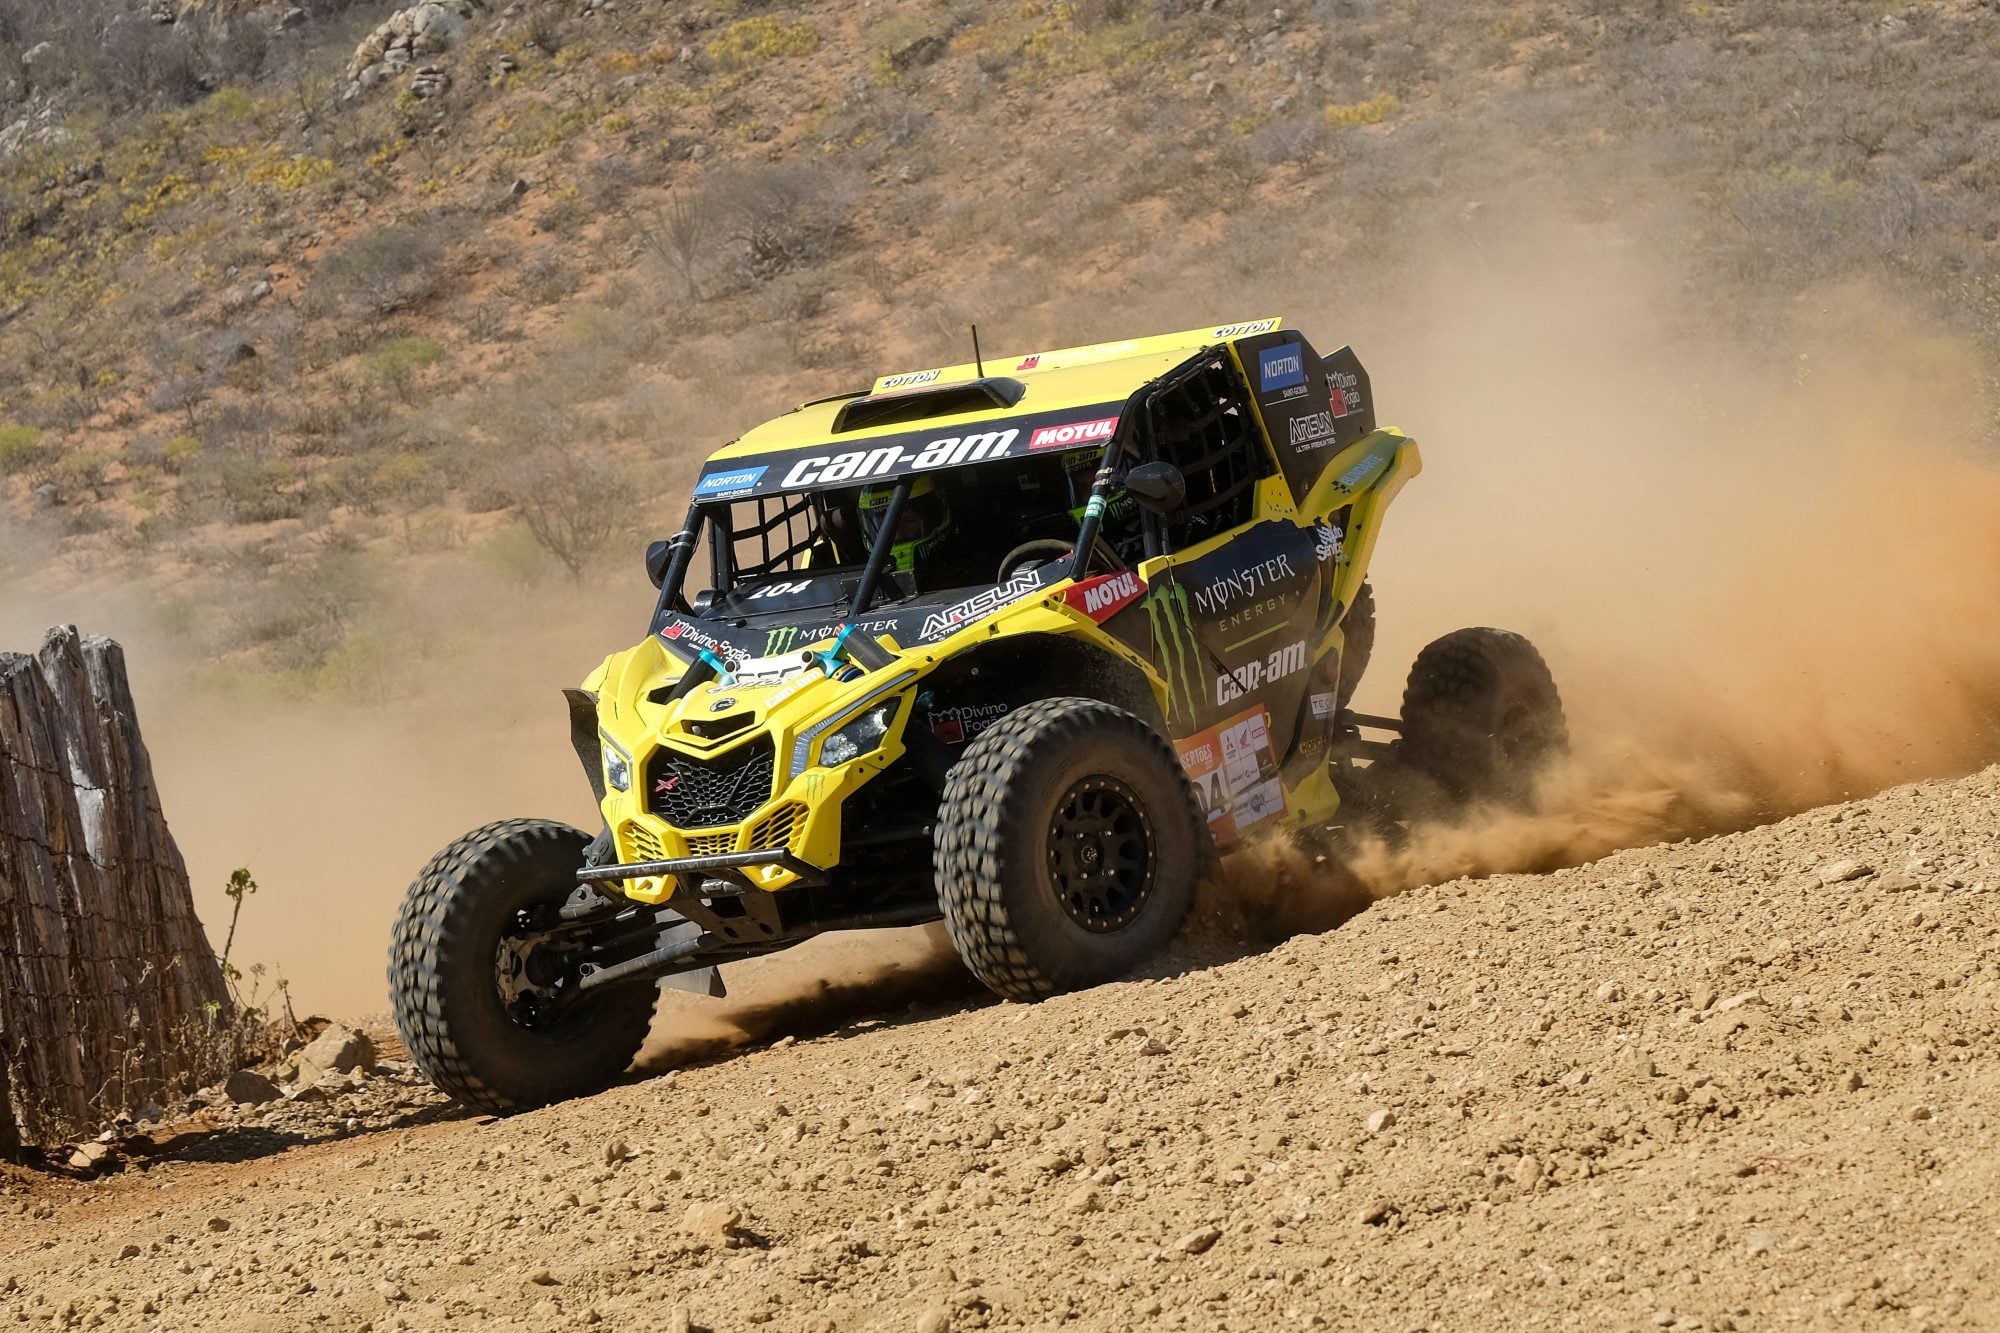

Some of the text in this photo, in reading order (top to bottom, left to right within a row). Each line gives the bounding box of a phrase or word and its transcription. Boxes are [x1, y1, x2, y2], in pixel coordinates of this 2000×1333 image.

[1212, 320, 1275, 338] COTTON
[1264, 356, 1299, 378] NORTON
[881, 370, 941, 388] COTTON
[1034, 420, 1113, 446] MOTUL
[1290, 411, 1335, 444] ARISUN
[702, 473, 758, 489] NORTON
[747, 579, 814, 601] 204
[1083, 572, 1139, 614] MOTUL
[1194, 553, 1296, 615] MONSTER
[918, 569, 1042, 640] ARISUN
[1219, 593, 1288, 632] ENERGY
[682, 626, 718, 649] Divino
[799, 619, 898, 641] MOTER
[928, 623, 962, 642] ULTRA
[960, 703, 1008, 720] Divino
